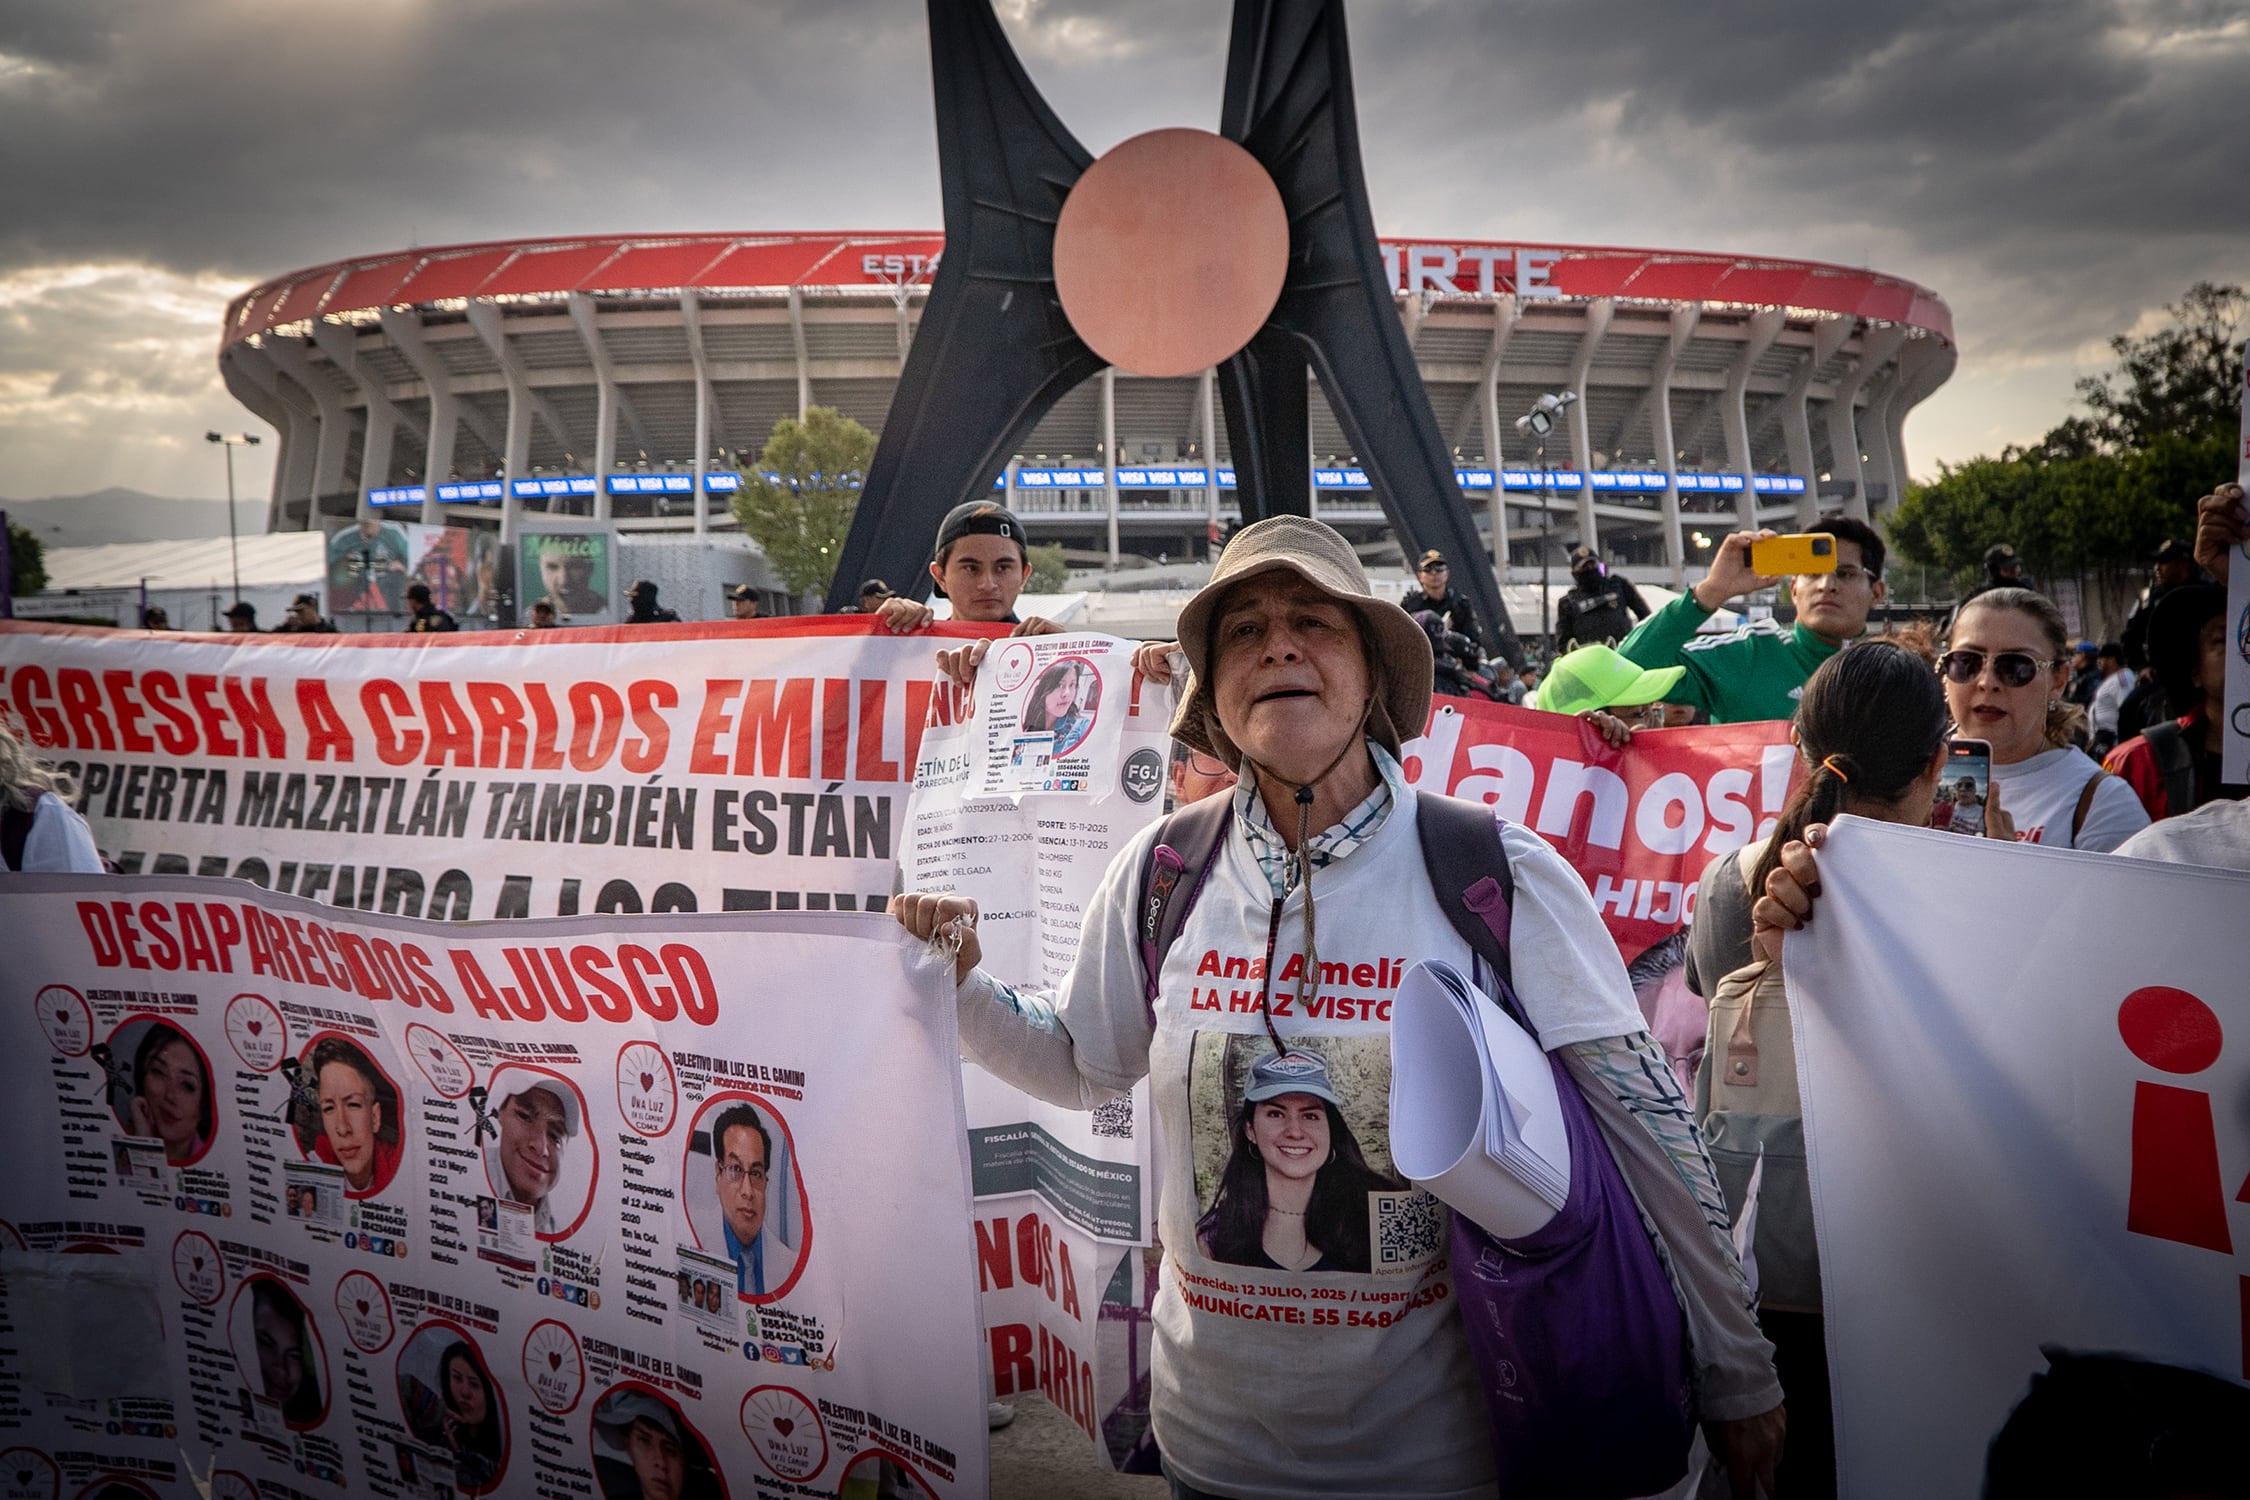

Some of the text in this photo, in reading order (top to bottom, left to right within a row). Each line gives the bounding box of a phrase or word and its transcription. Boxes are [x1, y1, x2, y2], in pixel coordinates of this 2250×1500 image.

[0, 664, 286, 759] GRESEN
[295, 678, 354, 763] A
[360, 678, 679, 774] CARLOS
[1128, 764, 1160, 781] FGJ
[235, 768, 475, 840] MAZATLÁN
[483, 774, 698, 851] TAMBIÉN
[712, 781, 892, 860] ESTÁN
[1069, 822, 1108, 833] 15-11-2025
[988, 832, 1033, 844] 27-12-2006
[1069, 838, 1108, 849] 13-11-2025
[952, 866, 992, 876] DELGADA
[1147, 896, 1161, 938] gear
[76, 900, 456, 1015] DESAPARECIDOS
[1196, 949, 1266, 980] Ana
[1190, 987, 1222, 1012] LA
[1228, 990, 1295, 1017] HAZ
[673, 1051, 805, 1088] COLECTIVO UNA LUZ EN EL CAMINO
[649, 1099, 664, 1113] LUZ
[620, 1148, 655, 1165] Santiago
[984, 1130, 1133, 1183] FISCALÍA MÉXICO
[631, 1198, 640, 1208] 12
[642, 1200, 664, 1214] Junio
[620, 1211, 641, 1225] 2020
[1103, 1227, 1133, 1238] México.
[1058, 1239, 1082, 1323] A
[1241, 1284, 1256, 1296] 12
[1310, 1288, 1346, 1301] 2025
[755, 1303, 799, 1323] Cualquier
[1312, 1308, 1340, 1326] 55
[983, 1321, 1097, 1443] RARLO
[818, 1397, 866, 1426] COLECTIVO
[866, 1411, 883, 1434] UNA
[884, 1420, 899, 1442] LUZ
[901, 1427, 912, 1447] EN
[913, 1433, 922, 1453] EL
[924, 1438, 956, 1470] CAMINO
